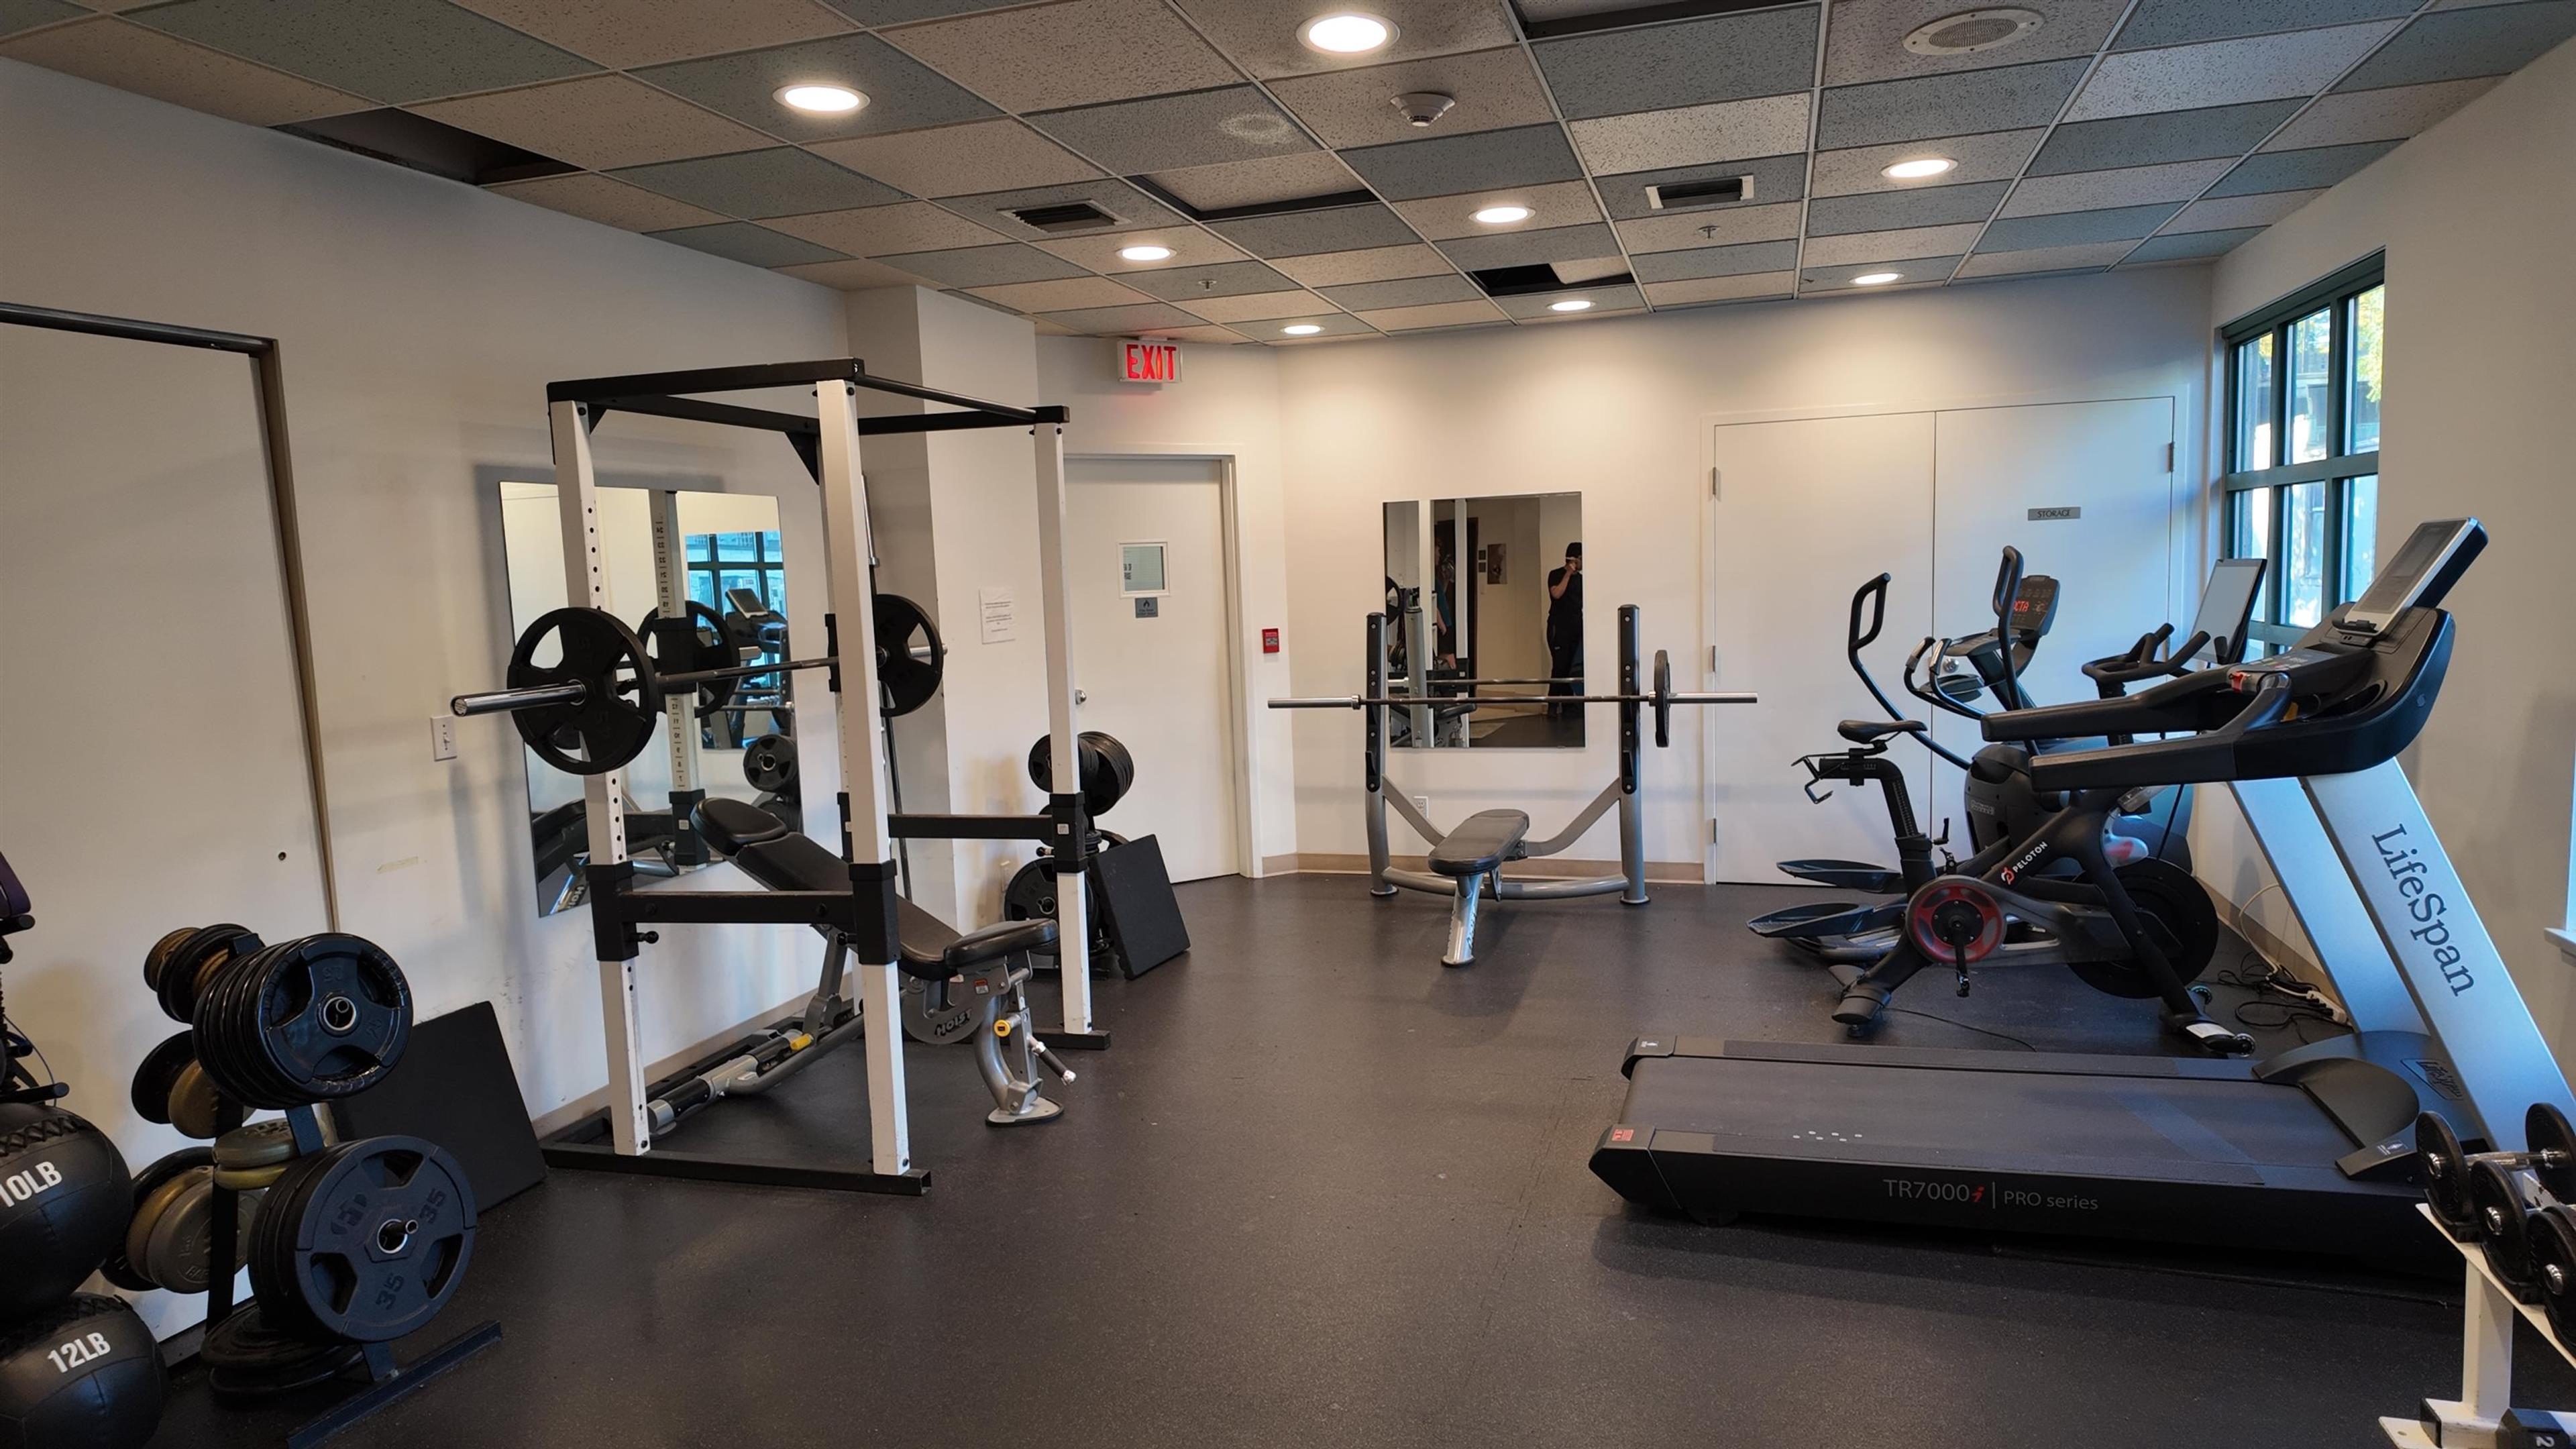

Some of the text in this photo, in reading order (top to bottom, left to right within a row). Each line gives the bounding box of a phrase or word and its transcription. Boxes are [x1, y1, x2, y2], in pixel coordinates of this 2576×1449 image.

[1126, 343, 1177, 380] EXIT
[2037, 509, 2070, 518] STORAGE
[2012, 841, 2047, 873] PELOTON
[2371, 823, 2474, 997] LifeSpan
[934, 1008, 973, 1036] HOIST
[0, 1161, 62, 1208] 10LB
[2004, 1190, 2041, 1207] PRO
[2047, 1194, 2098, 1210] series
[419, 1188, 446, 1224] 35
[375, 1272, 405, 1309] 35
[47, 1332, 111, 1374] 12LB
